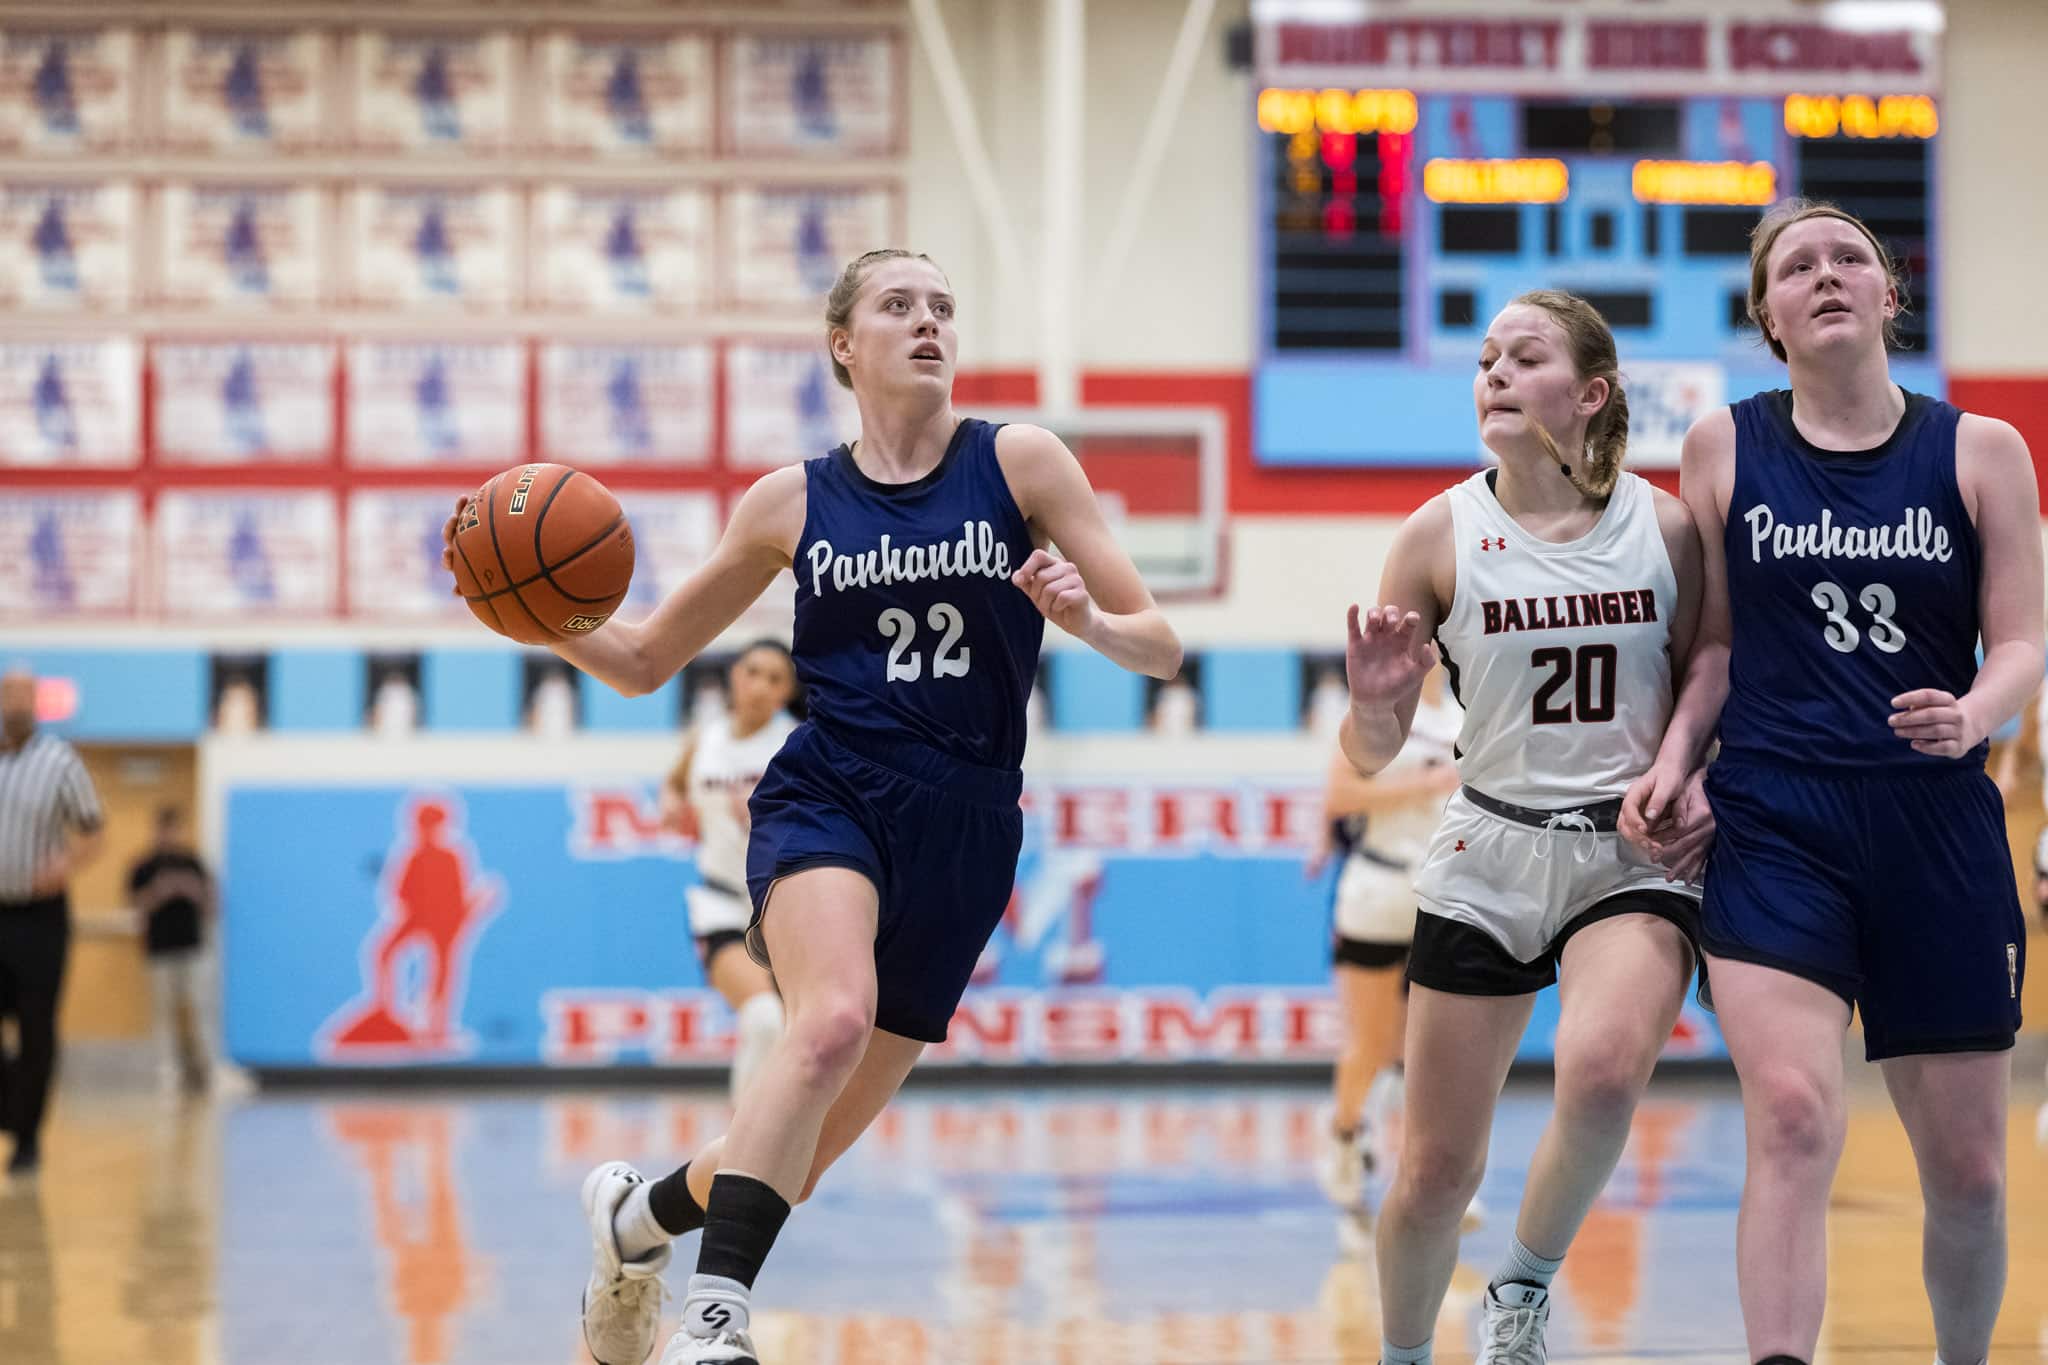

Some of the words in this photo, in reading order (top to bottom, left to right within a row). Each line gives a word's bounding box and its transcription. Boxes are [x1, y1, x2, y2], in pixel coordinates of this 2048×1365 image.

[807, 520, 1012, 597] Panhandle
[1743, 503, 1953, 563] Panhandle
[876, 602, 971, 683] 22
[1480, 589, 1659, 635] BALLINGER
[1810, 581, 1907, 654] 33
[1530, 643, 1618, 725] 20
